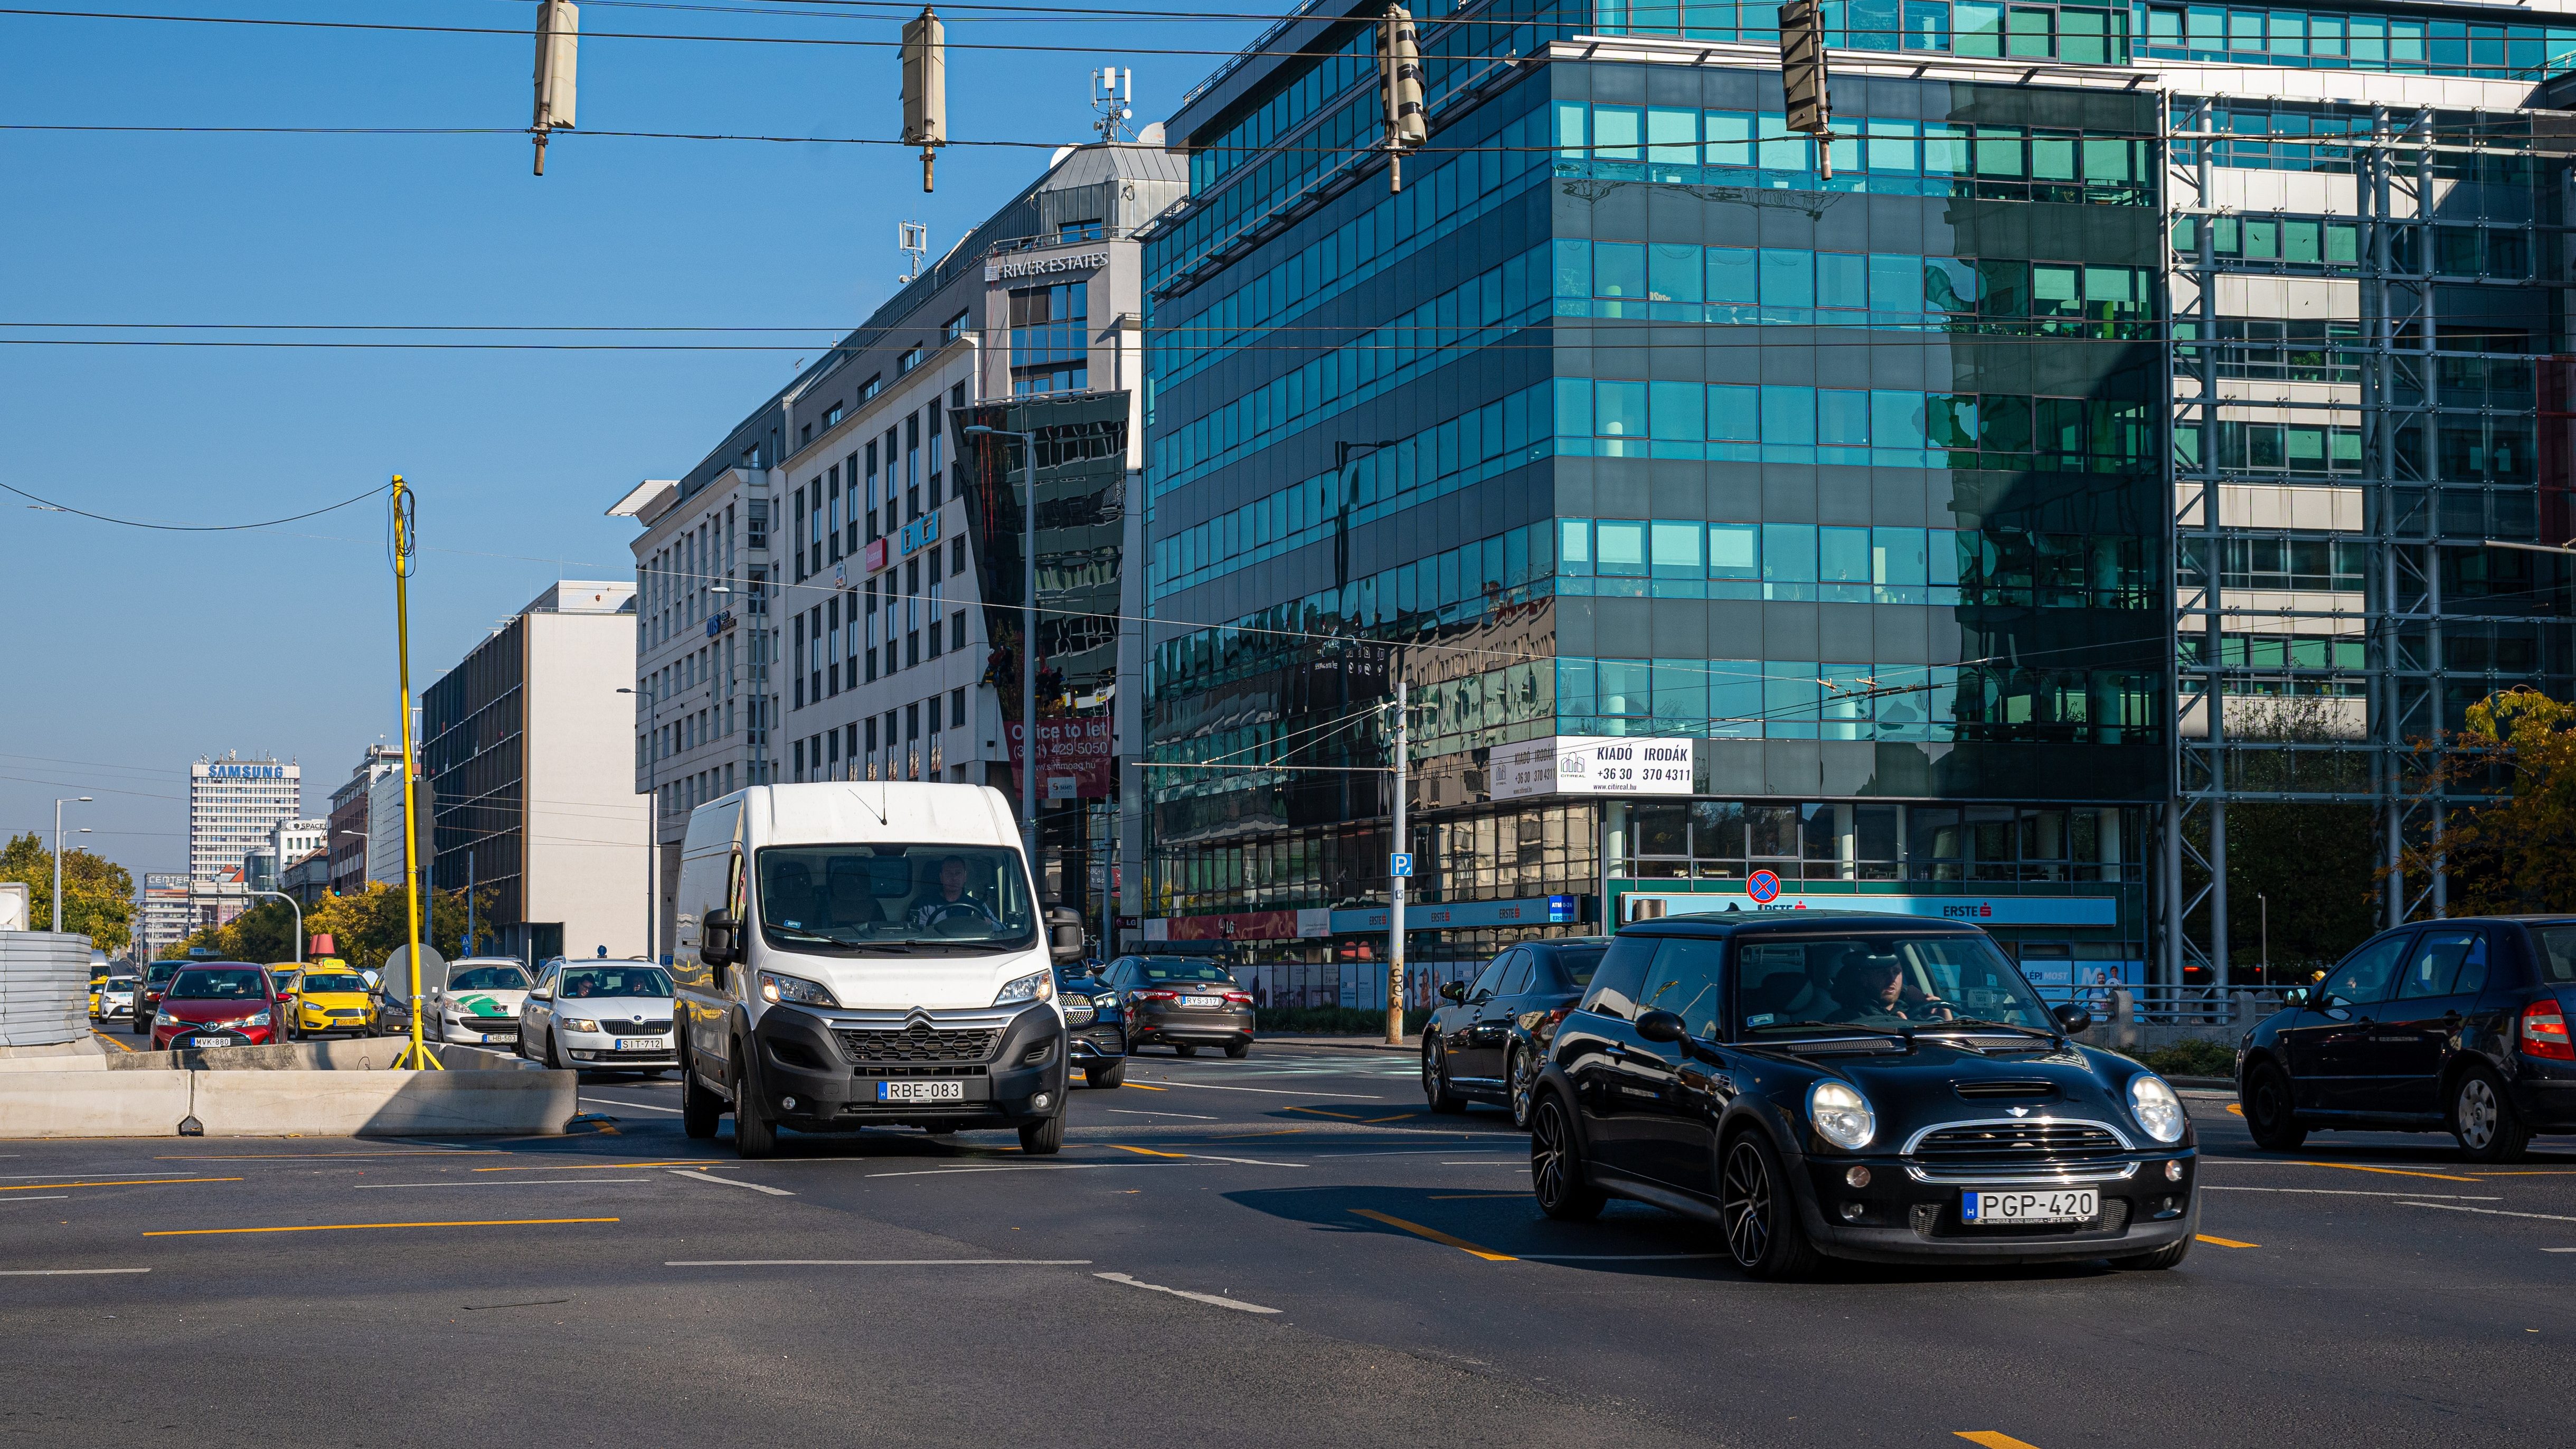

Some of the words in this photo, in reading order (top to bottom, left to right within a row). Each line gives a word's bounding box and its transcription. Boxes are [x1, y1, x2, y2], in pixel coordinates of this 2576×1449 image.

[1004, 260, 1045, 278] RIVER
[1050, 251, 1108, 272] ESTATES
[901, 511, 938, 556] DIGI
[706, 614, 719, 638] OTIS
[1012, 723, 1060, 740] Oice
[1064, 723, 1081, 738] to
[1087, 721, 1107, 737] let
[1052, 743, 1073, 755] 429
[1078, 741, 1108, 755] 5050
[1515, 746, 1530, 766] KIADÓ
[1535, 743, 1554, 763] IRODÁK
[1597, 744, 1633, 760] KIADÓ
[1644, 745, 1688, 761] IRODÁK
[209, 765, 284, 778] SAMSUNG
[1515, 772, 1523, 784] +36
[1524, 771, 1531, 783] 30
[1534, 769, 1543, 782] 370
[1544, 767, 1555, 780] 4311
[1598, 768, 1616, 780] +36
[1619, 768, 1633, 780] 30
[1643, 769, 1662, 780] 370
[1665, 769, 1690, 781] 4311
[1395, 856, 1408, 874] P
[1431, 912, 1445, 923] ERSTE
[1499, 908, 1514, 919] ERSTE
[1943, 906, 1978, 917] ERSTE
[1226, 921, 1234, 933] LG
[1369, 916, 1382, 926] ERSTE
[2025, 970, 2042, 980] LÉPJ
[2043, 972, 2068, 980] MOST
[890, 1084, 959, 1098] RBE-083
[1983, 1193, 2092, 1217] PGP-420
